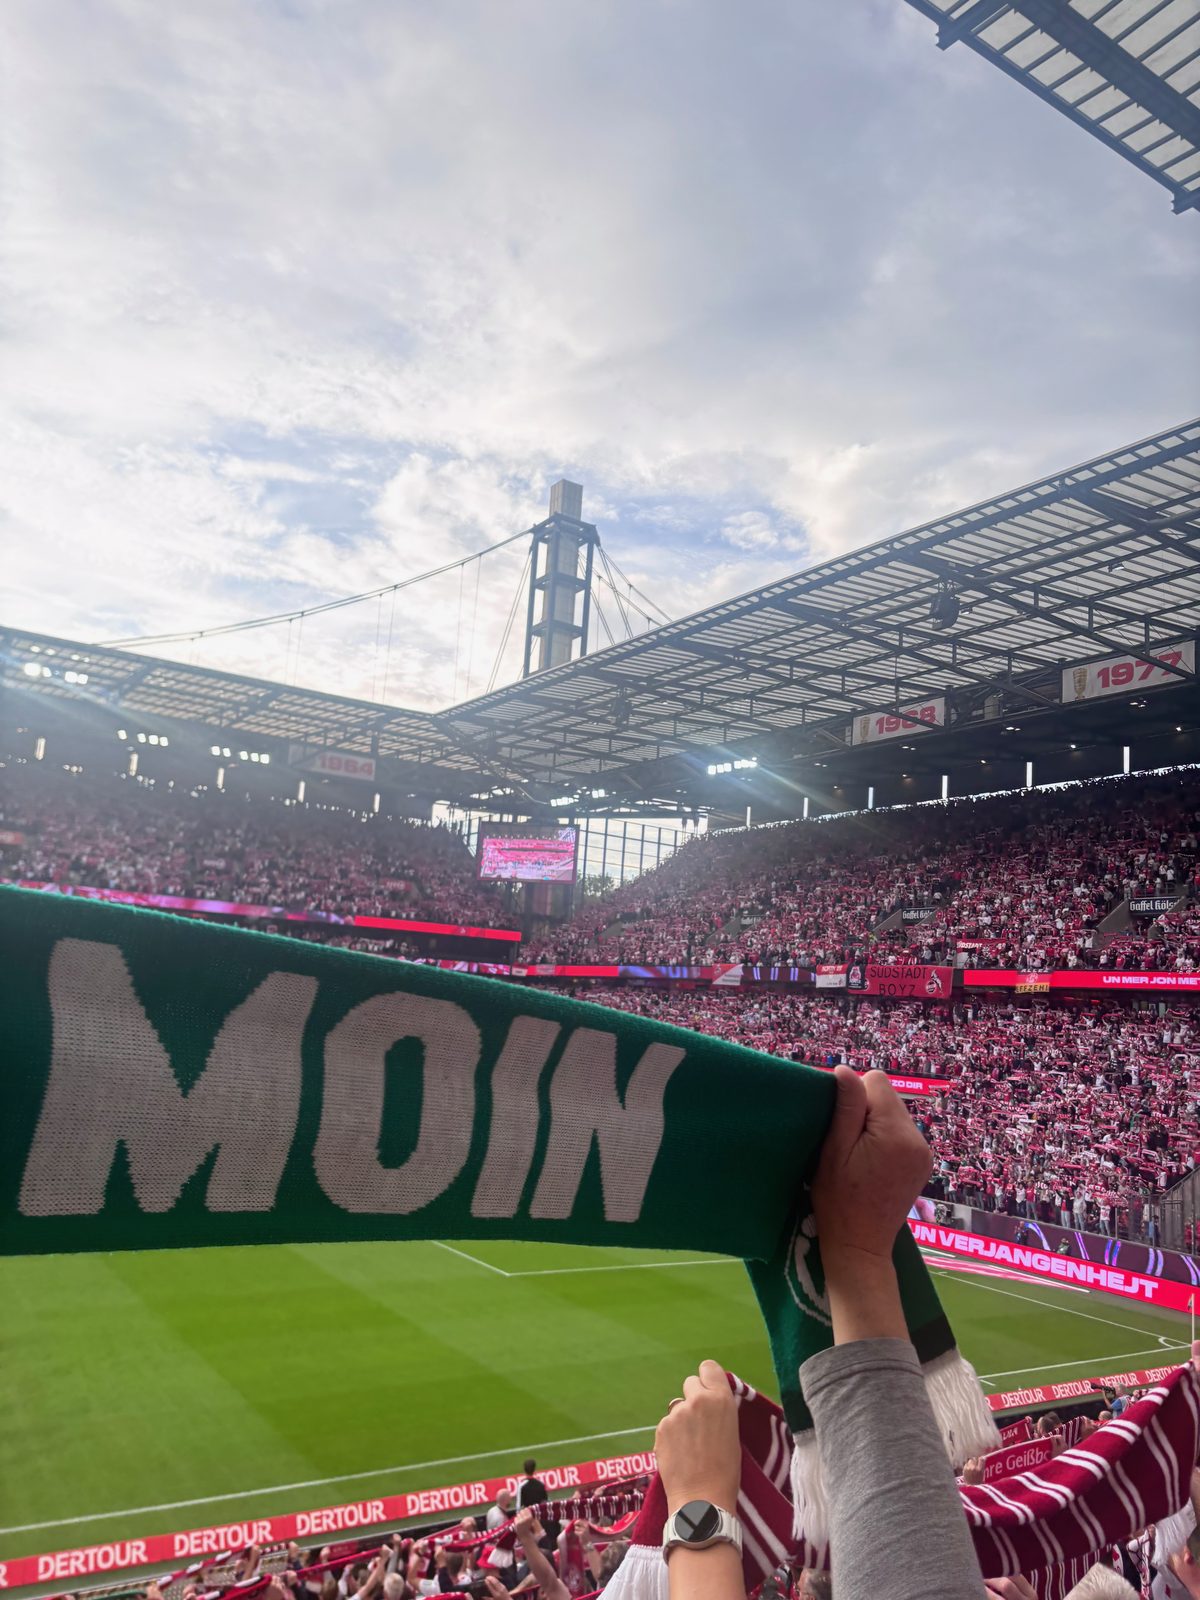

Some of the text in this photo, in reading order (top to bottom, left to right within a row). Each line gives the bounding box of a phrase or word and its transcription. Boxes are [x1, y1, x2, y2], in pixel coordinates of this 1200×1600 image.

[1097, 650, 1183, 689] 1977
[876, 705, 937, 735] 1968
[319, 754, 373, 777] 1964
[1130, 901, 1154, 911] Gaffel
[879, 983, 916, 996] BOYZ
[1103, 976, 1200, 985] UN MER JON ME
[18, 937, 686, 1223] MOIN
[906, 1082, 923, 1090] DIR
[938, 1230, 1159, 1298] VERJANGENHEJT
[1000, 1388, 1044, 1408] DERTOUR
[1051, 1382, 1093, 1398] DERTOUR
[38, 1541, 148, 1580] DERTOUR
[174, 1520, 273, 1557] DERTOUR
[295, 1500, 387, 1536] DERTOUR
[406, 1483, 488, 1515] DERTOUR
[506, 1466, 581, 1497] DETOUR
